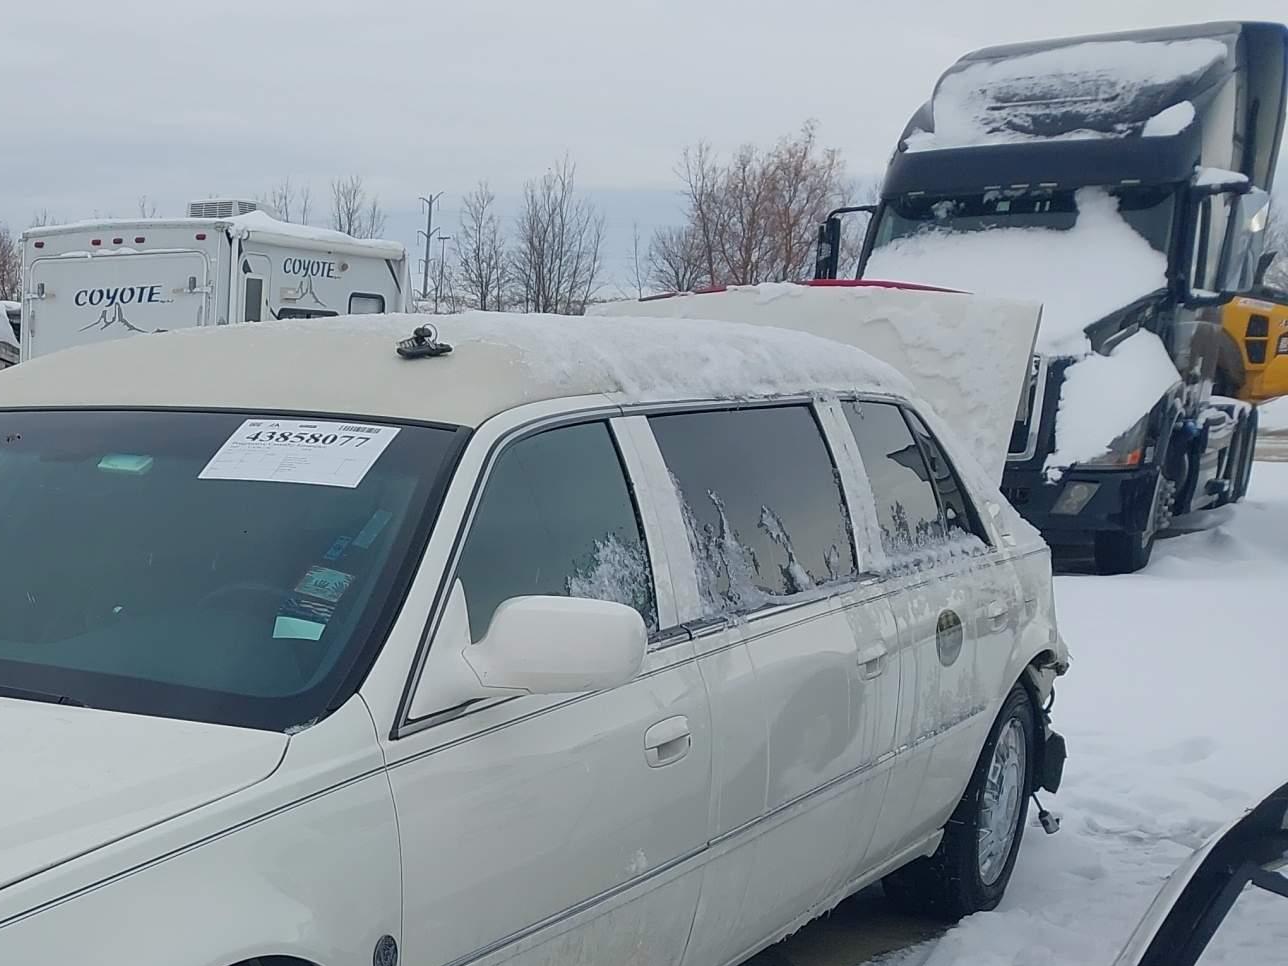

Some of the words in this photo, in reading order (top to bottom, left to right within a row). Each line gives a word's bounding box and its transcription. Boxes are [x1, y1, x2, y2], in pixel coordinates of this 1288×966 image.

[282, 257, 336, 278] COYOTE
[74, 284, 163, 308] COYOTE
[245, 430, 372, 449] 43858077
